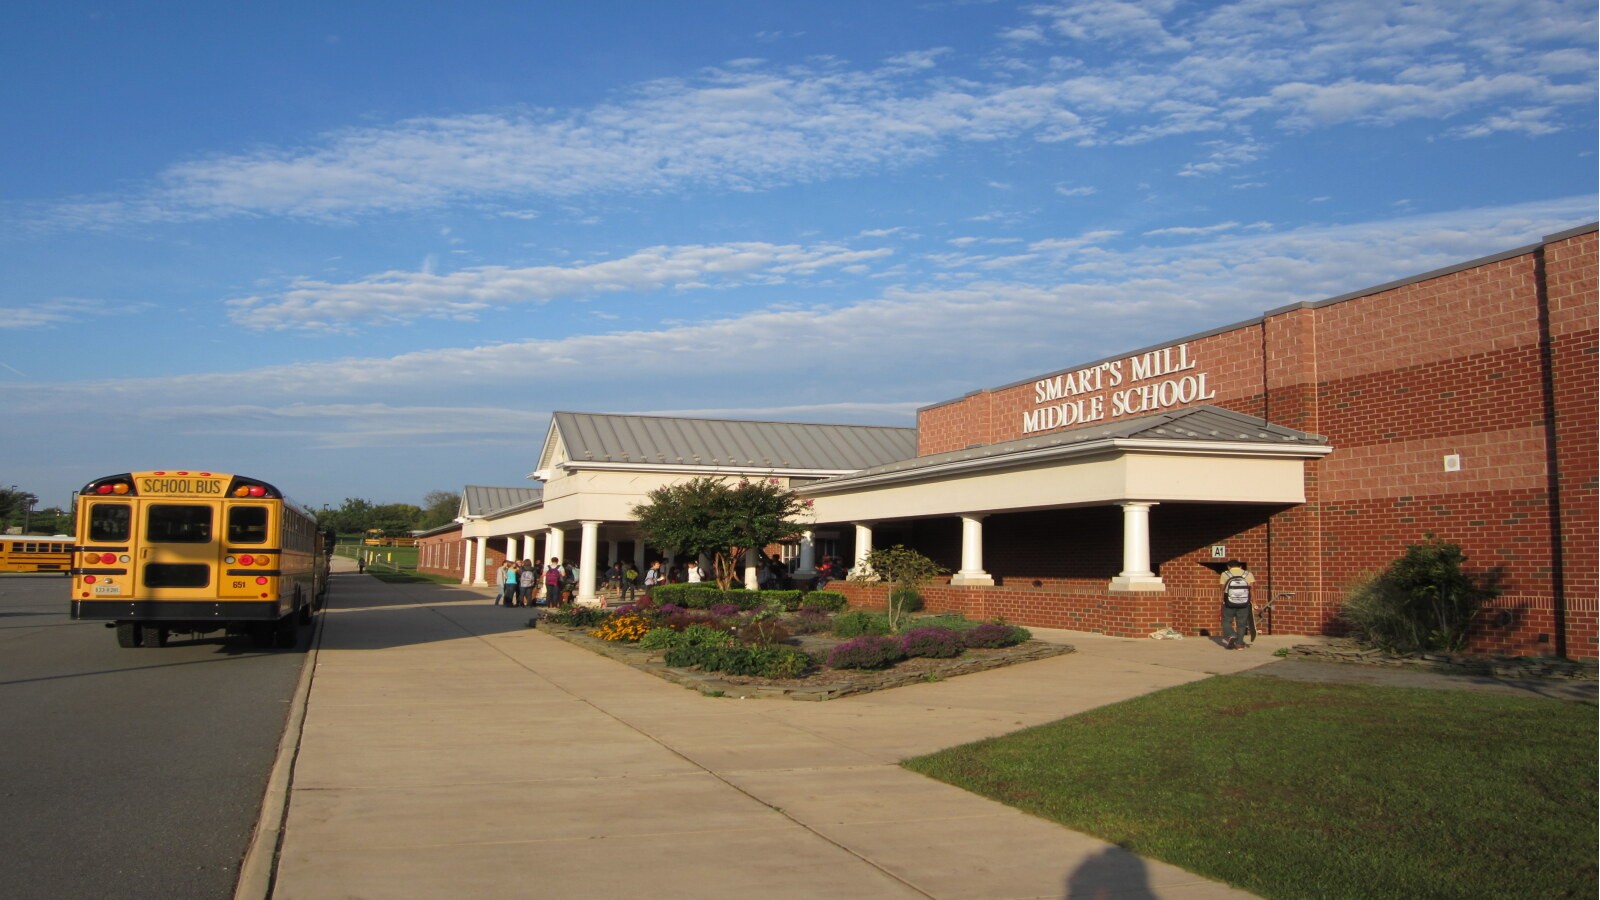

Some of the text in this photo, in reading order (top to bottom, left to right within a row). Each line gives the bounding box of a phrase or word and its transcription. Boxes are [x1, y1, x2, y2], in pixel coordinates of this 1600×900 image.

[1035, 343, 1196, 404] SMART'S MILL
[1022, 372, 1216, 434] MIDDLE SCHOOL
[143, 478, 221, 494] SCHOOL BUS
[1214, 547, 1223, 556] A1
[232, 581, 246, 589] 651
